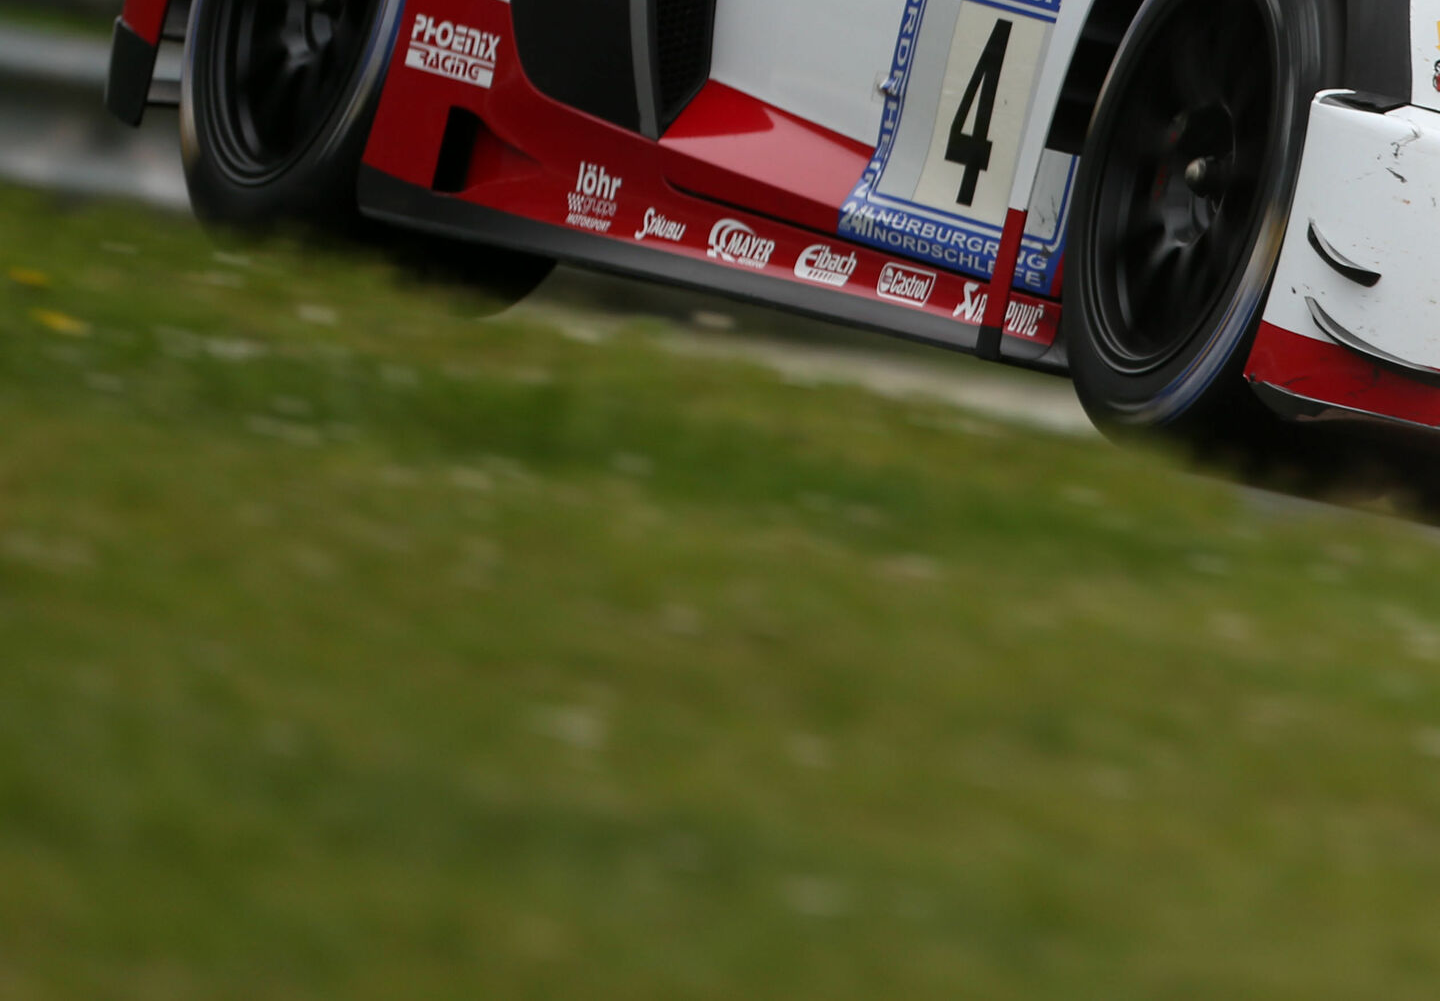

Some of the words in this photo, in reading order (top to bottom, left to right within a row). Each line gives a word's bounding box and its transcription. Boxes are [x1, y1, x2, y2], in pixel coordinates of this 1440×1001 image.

[944, 18, 1013, 207] 4
[575, 160, 622, 200] löhr
[582, 197, 617, 217] gruppe
[728, 231, 775, 264] MAYER
[794, 243, 858, 278] Eibach
[889, 270, 932, 300] Castrol
